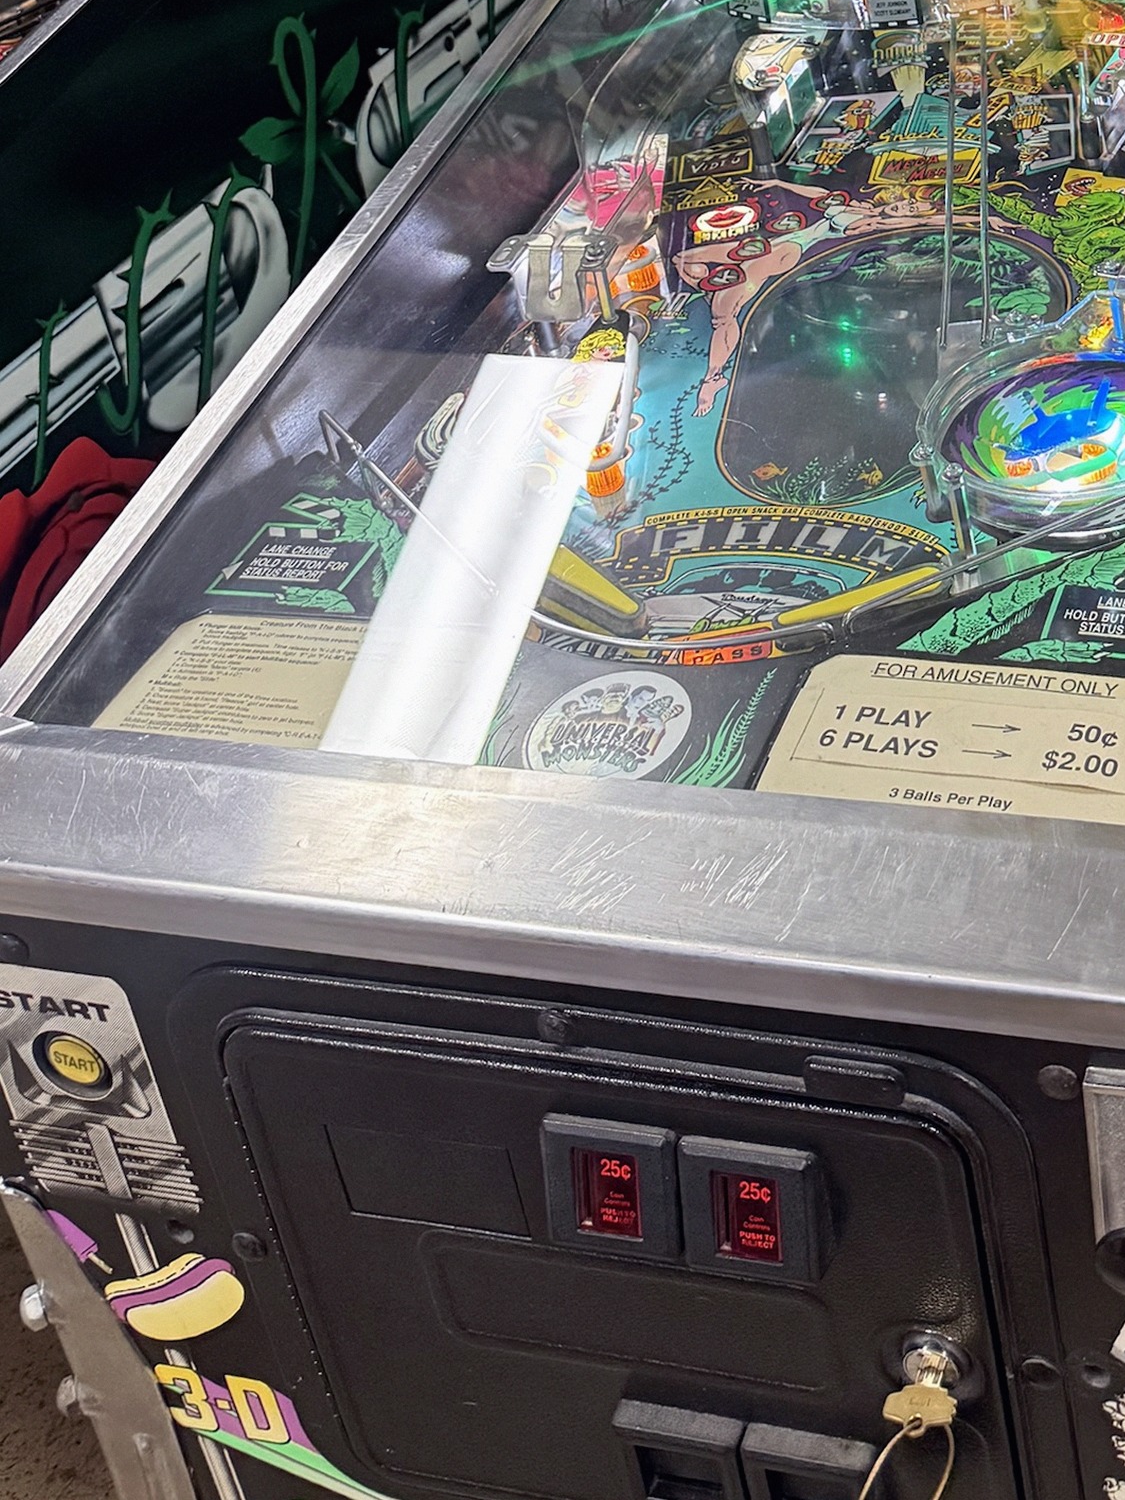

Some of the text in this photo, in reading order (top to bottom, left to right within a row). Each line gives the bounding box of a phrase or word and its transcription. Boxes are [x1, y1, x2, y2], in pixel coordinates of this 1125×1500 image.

[647, 511, 691, 525] COMPLETE
[726, 508, 749, 516] OPEN
[751, 507, 780, 515] SNACK
[782, 507, 799, 515] BAR
[803, 509, 845, 521] COMPLETE
[873, 519, 907, 535] SHOOT
[908, 528, 940, 545] SLIDE
[261, 543, 336, 557] LANE CHANGE
[242, 567, 326, 580] STATUS REPORT
[250, 557, 349, 572] HOLD BUTTON FOR
[1064, 608, 1099, 622] HOLD
[1079, 620, 1124, 635] STATUS
[872, 661, 1119, 698] FOR AMUSEMENT ONLY
[551, 719, 655, 757] UNIVERSAL
[835, 704, 1119, 749] 1 PLAY 50¢
[819, 729, 1119, 779] 6 PLAYS $2.00
[889, 786, 1013, 812] 3 Balls Per Play
[0, 990, 110, 1023] START
[53, 1050, 96, 1074] START
[600, 1158, 632, 1181] 25¢
[739, 1180, 771, 1203] 25¢
[739, 1231, 776, 1243] PUSH TO
[154, 1362, 292, 1444] 3-D
